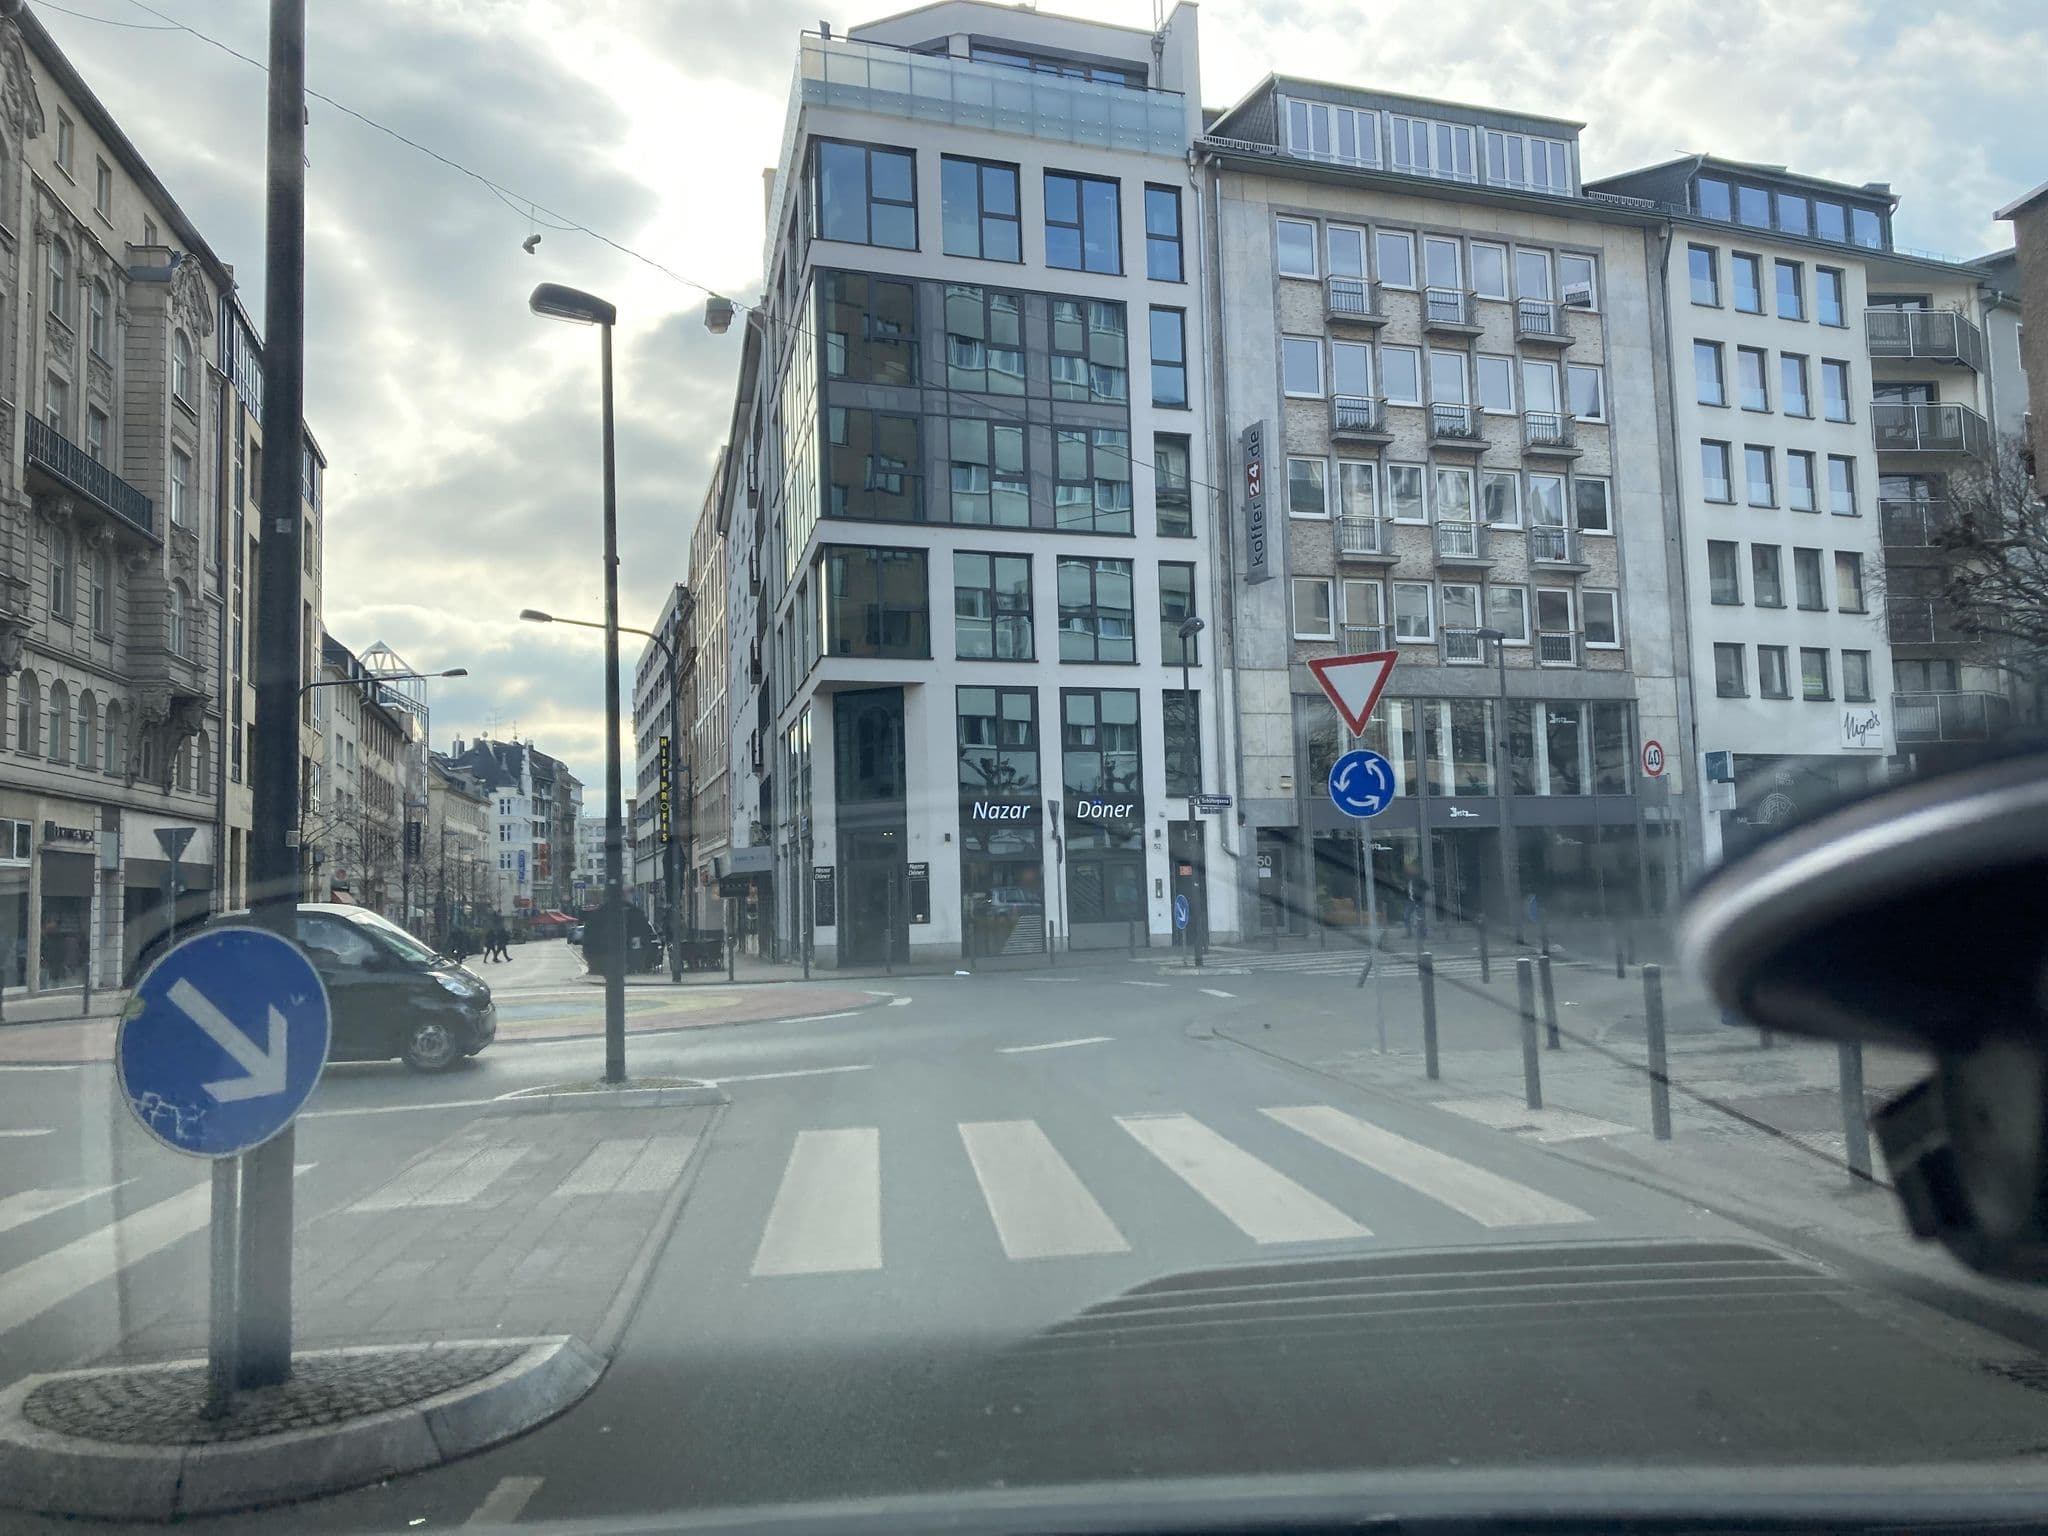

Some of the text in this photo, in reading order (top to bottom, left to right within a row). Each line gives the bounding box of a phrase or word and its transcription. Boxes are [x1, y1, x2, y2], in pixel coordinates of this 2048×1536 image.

[1647, 749, 1660, 765] 40
[661, 782, 669, 842] PROFIS
[972, 799, 1133, 820] Nazar Döner
